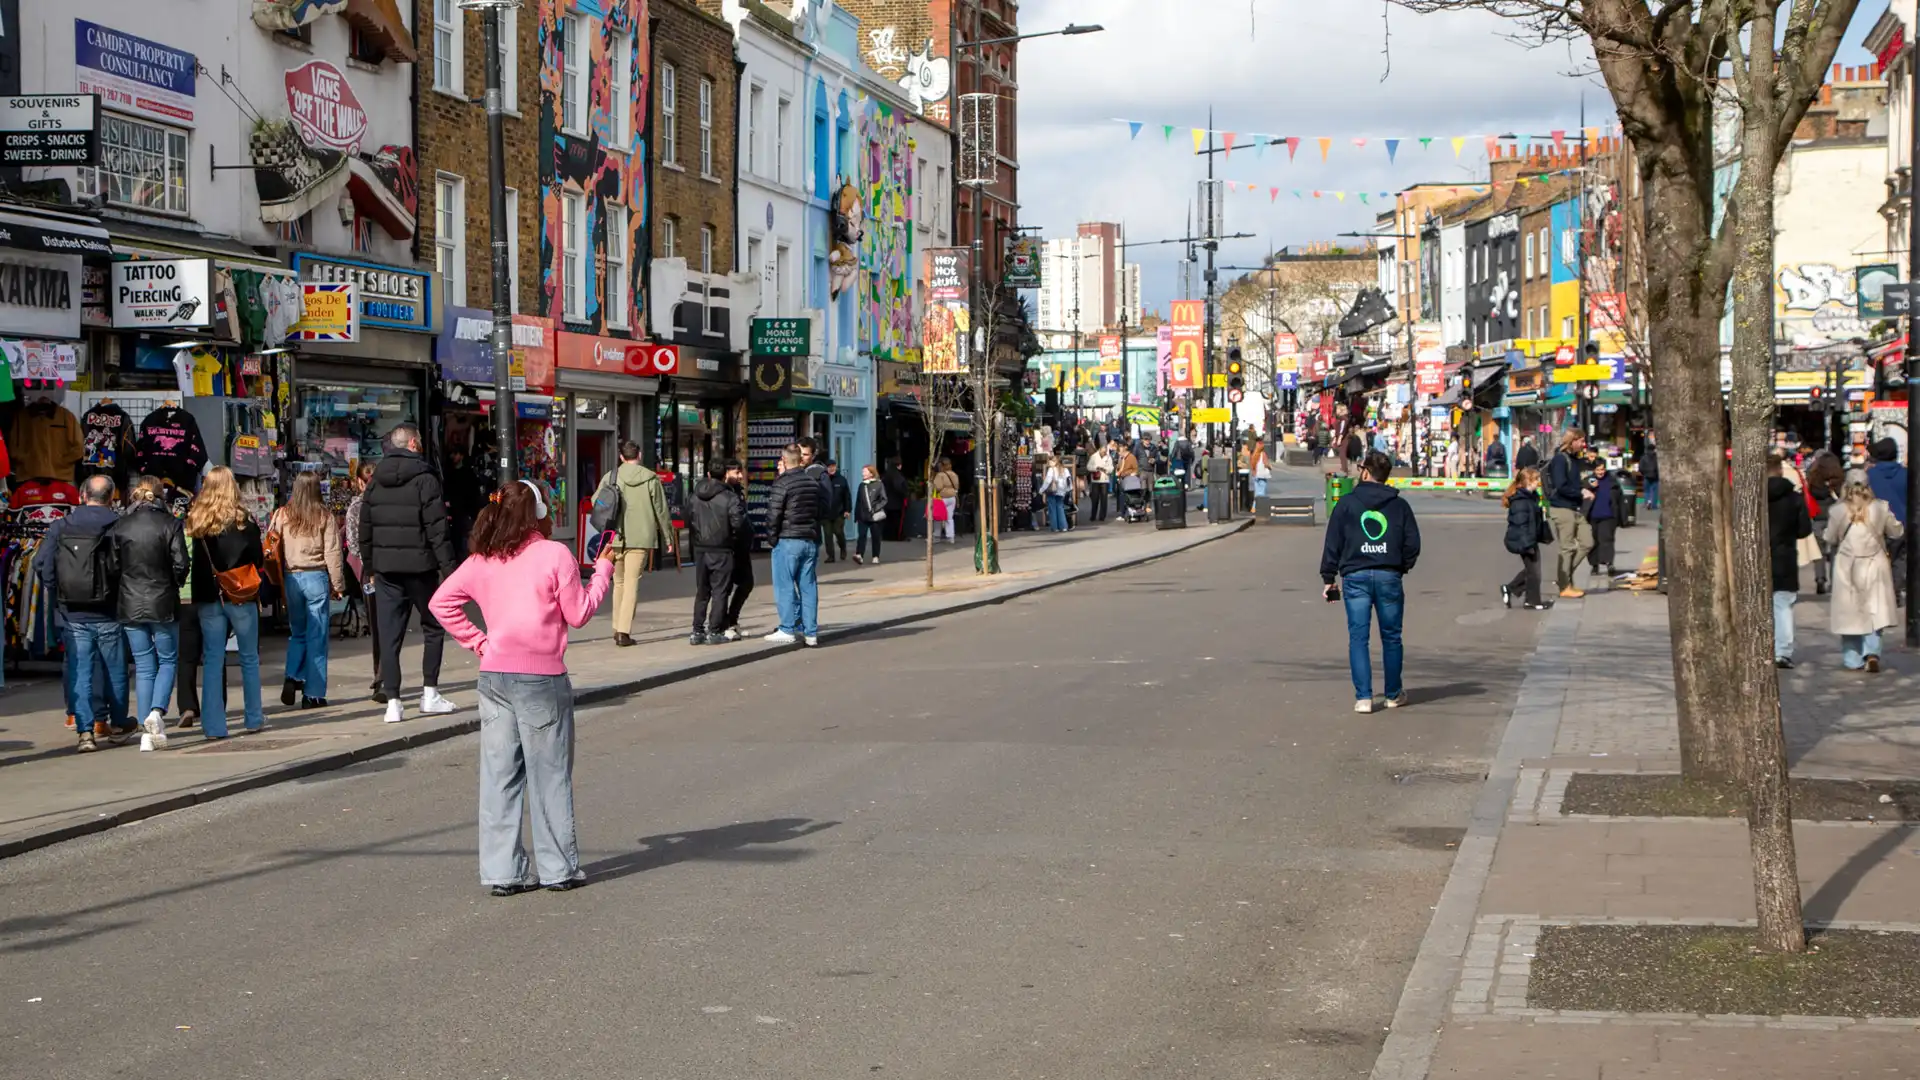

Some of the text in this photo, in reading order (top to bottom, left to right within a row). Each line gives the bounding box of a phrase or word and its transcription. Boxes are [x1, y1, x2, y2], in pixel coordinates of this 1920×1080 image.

[87, 28, 186, 72] CAMDEN PROPERTY
[100, 52, 175, 87] CONSULTANCY
[311, 66, 341, 102] VANS
[10, 98, 80, 109] SOUVENIRS
[42, 110, 50, 118] &
[313, 96, 336, 137] THE
[28, 119, 62, 129] GIFTS
[6, 135, 39, 146] CRISPS
[47, 134, 86, 145] SNACKS
[101, 116, 164, 153] ESTATE
[4, 150, 43, 161] SWEETS
[51, 149, 88, 160] DRINKS
[101, 146, 164, 180] AGENTS
[41, 235, 81, 249] Disturbed
[124, 265, 175, 281] TATTOO
[119, 286, 181, 303] PIERCING
[326, 294, 341, 304] De
[134, 308, 168, 318] WALK-INS
[369, 301, 415, 321] FOOTWEAR
[766, 329, 796, 337] MONEY
[757, 337, 804, 345] EXCHANGE
[239, 438, 255, 447] SALE
[1360, 541, 1387, 553] dwel
